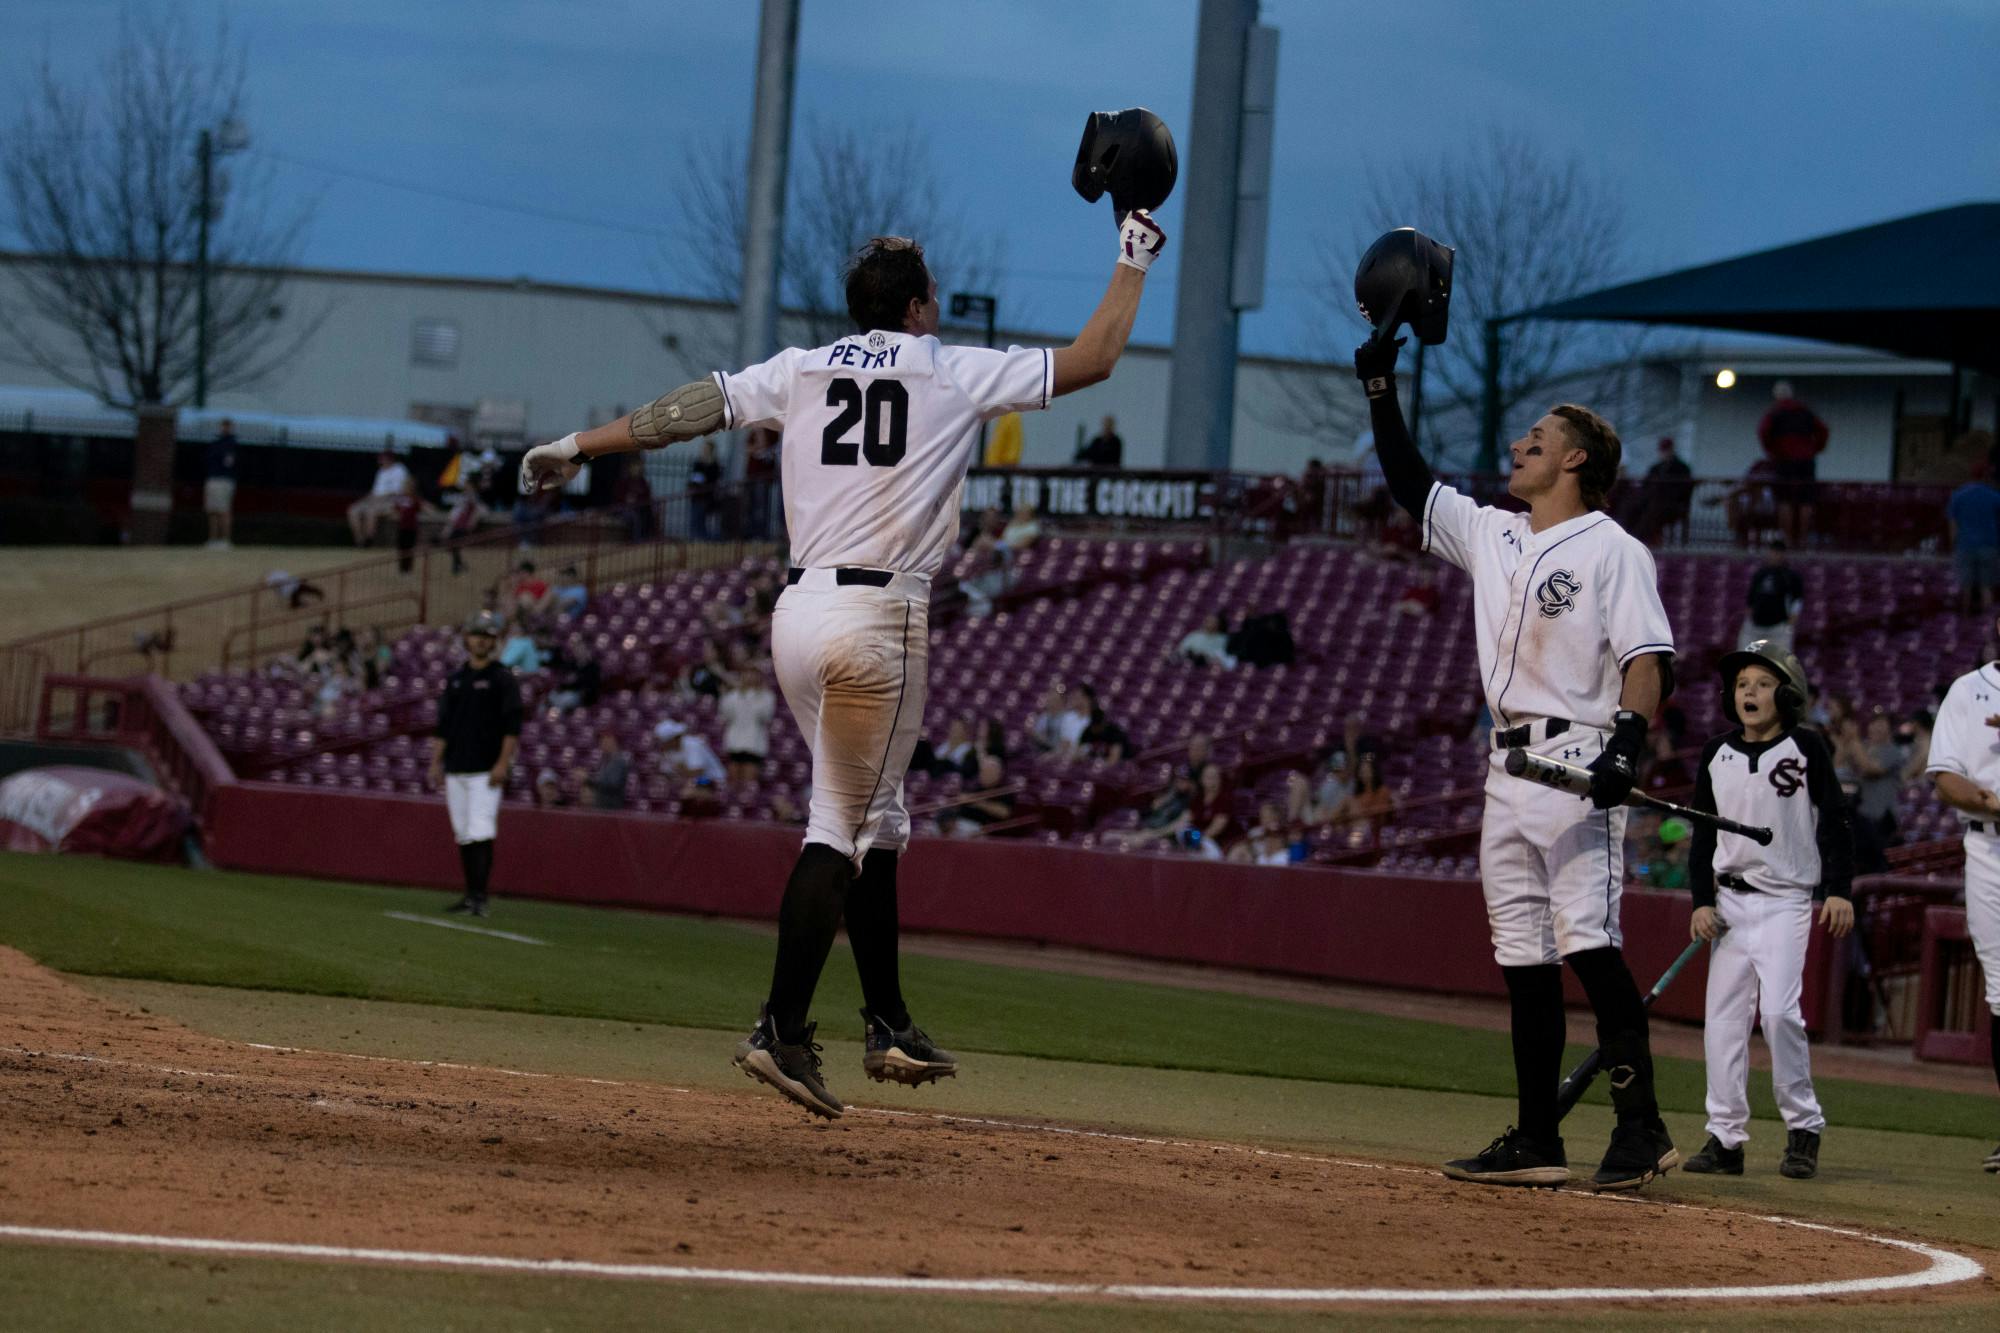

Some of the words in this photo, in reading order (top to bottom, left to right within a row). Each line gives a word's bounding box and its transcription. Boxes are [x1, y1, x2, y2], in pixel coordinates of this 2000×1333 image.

[828, 344, 901, 369] PETRY
[821, 378, 909, 467] 20
[1011, 475, 1041, 510] TO
[1047, 476, 1088, 514] THE
[1095, 478, 1196, 518] COCKPIT
